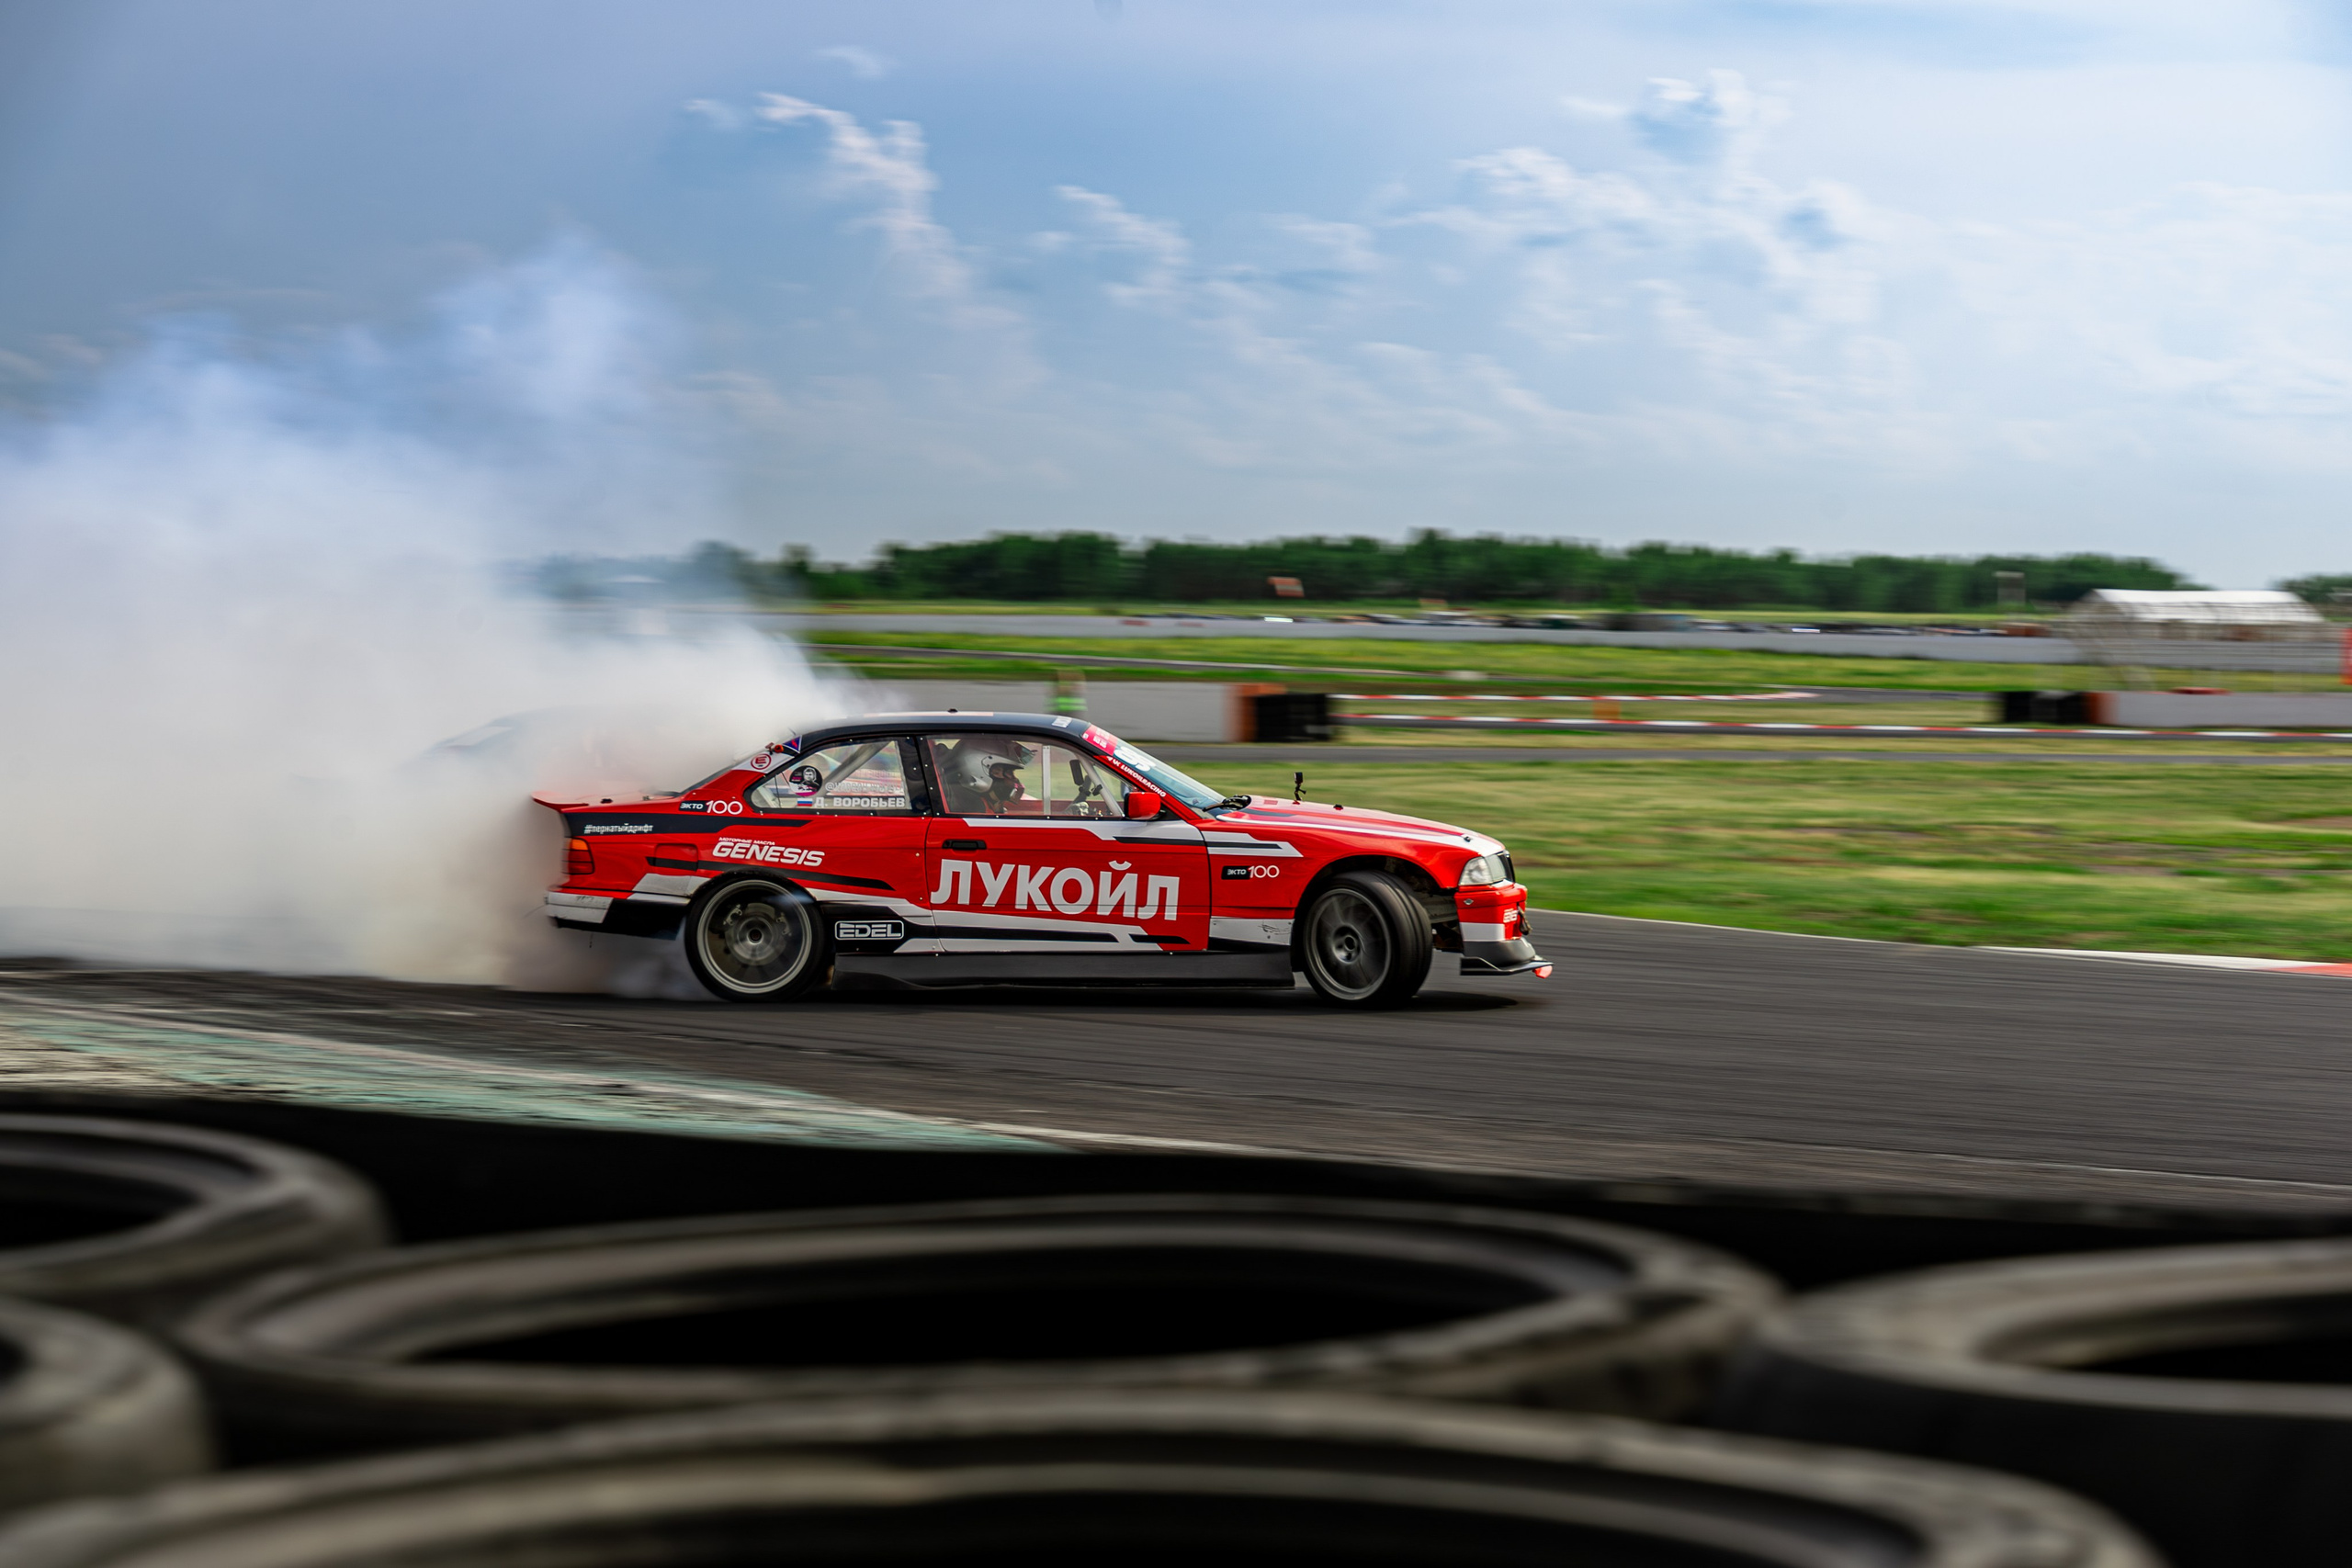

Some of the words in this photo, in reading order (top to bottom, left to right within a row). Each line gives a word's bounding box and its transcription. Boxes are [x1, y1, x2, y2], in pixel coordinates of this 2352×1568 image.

[680, 802, 704, 810] ЭКТО
[706, 800, 743, 815] 100
[815, 796, 829, 808] Д.
[833, 797, 905, 807] ВОРОБЬЕВ
[712, 841, 825, 867] GENESIS
[1248, 865, 1280, 878] 100
[931, 859, 1180, 921] ЛУКОЙЛ
[839, 922, 901, 938] EDEL
